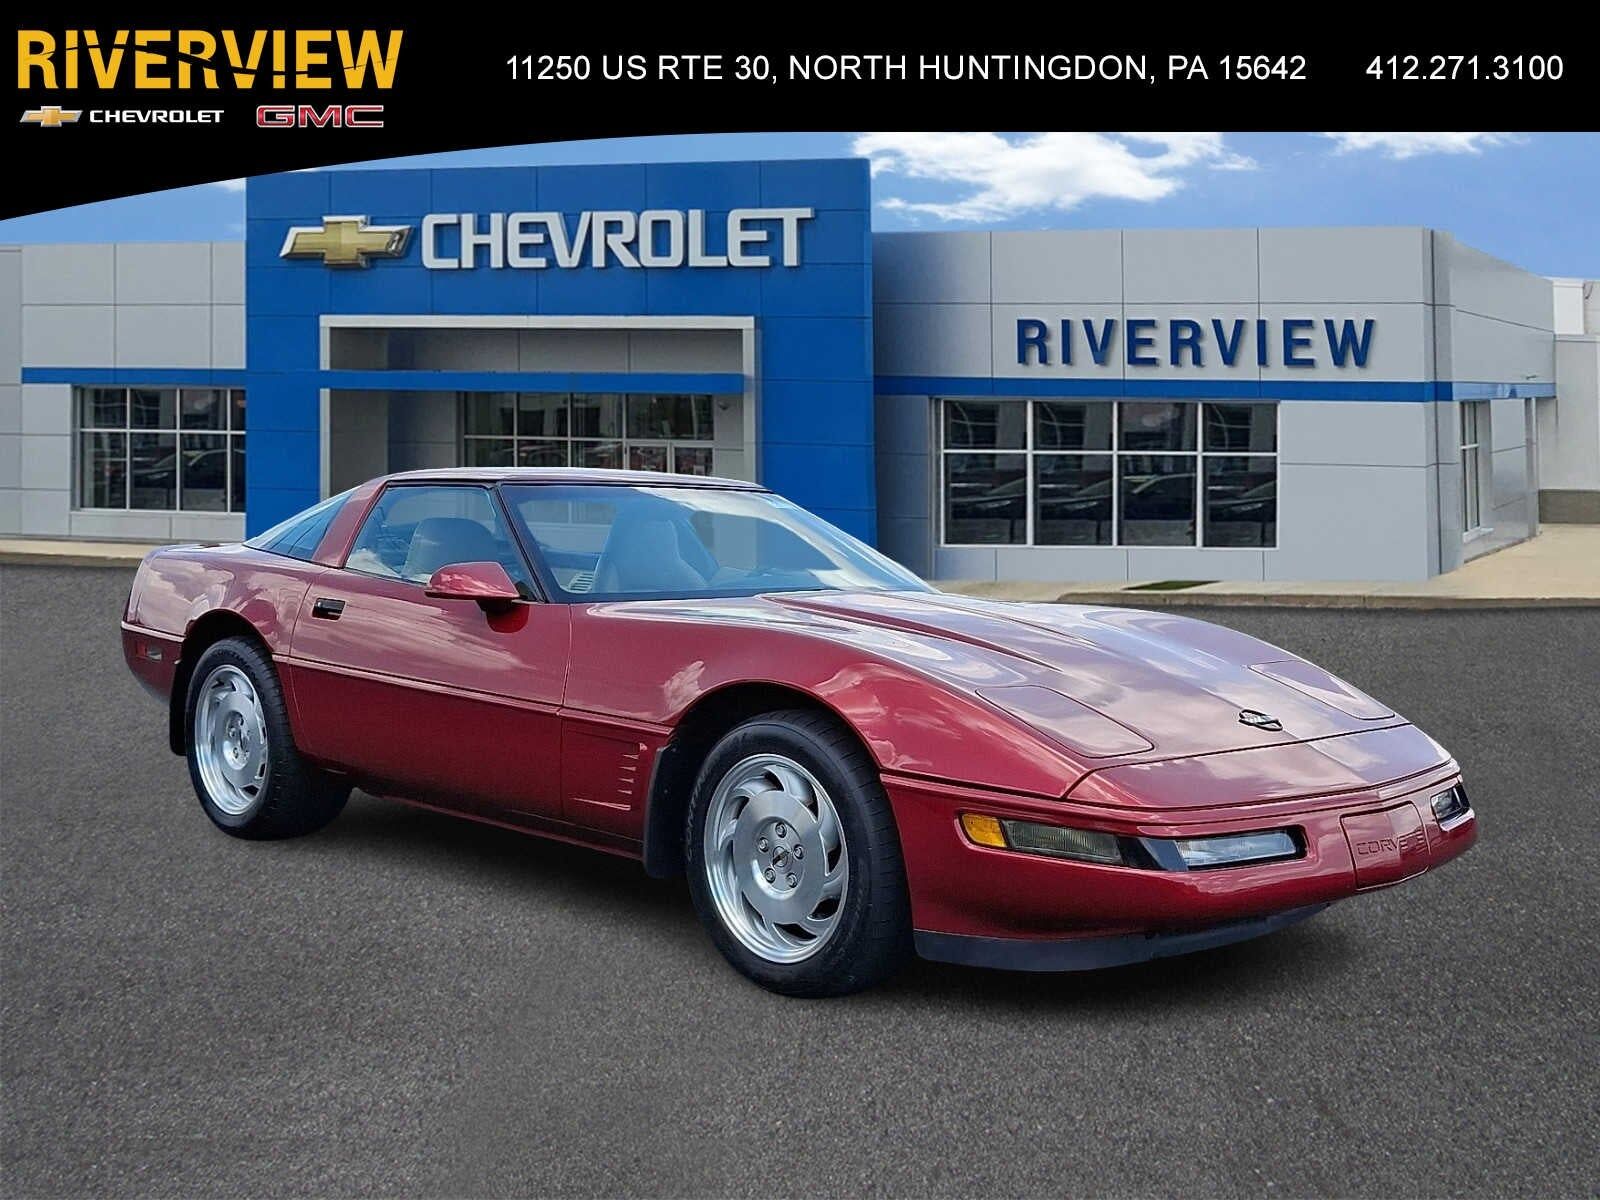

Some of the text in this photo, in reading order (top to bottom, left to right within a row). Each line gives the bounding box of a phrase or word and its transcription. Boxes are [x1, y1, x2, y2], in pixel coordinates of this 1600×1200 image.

[421, 207, 815, 270] CHEVROLET
[1016, 318, 1376, 368] RIVERVIEW
[1356, 830, 1427, 855] CORVEE
